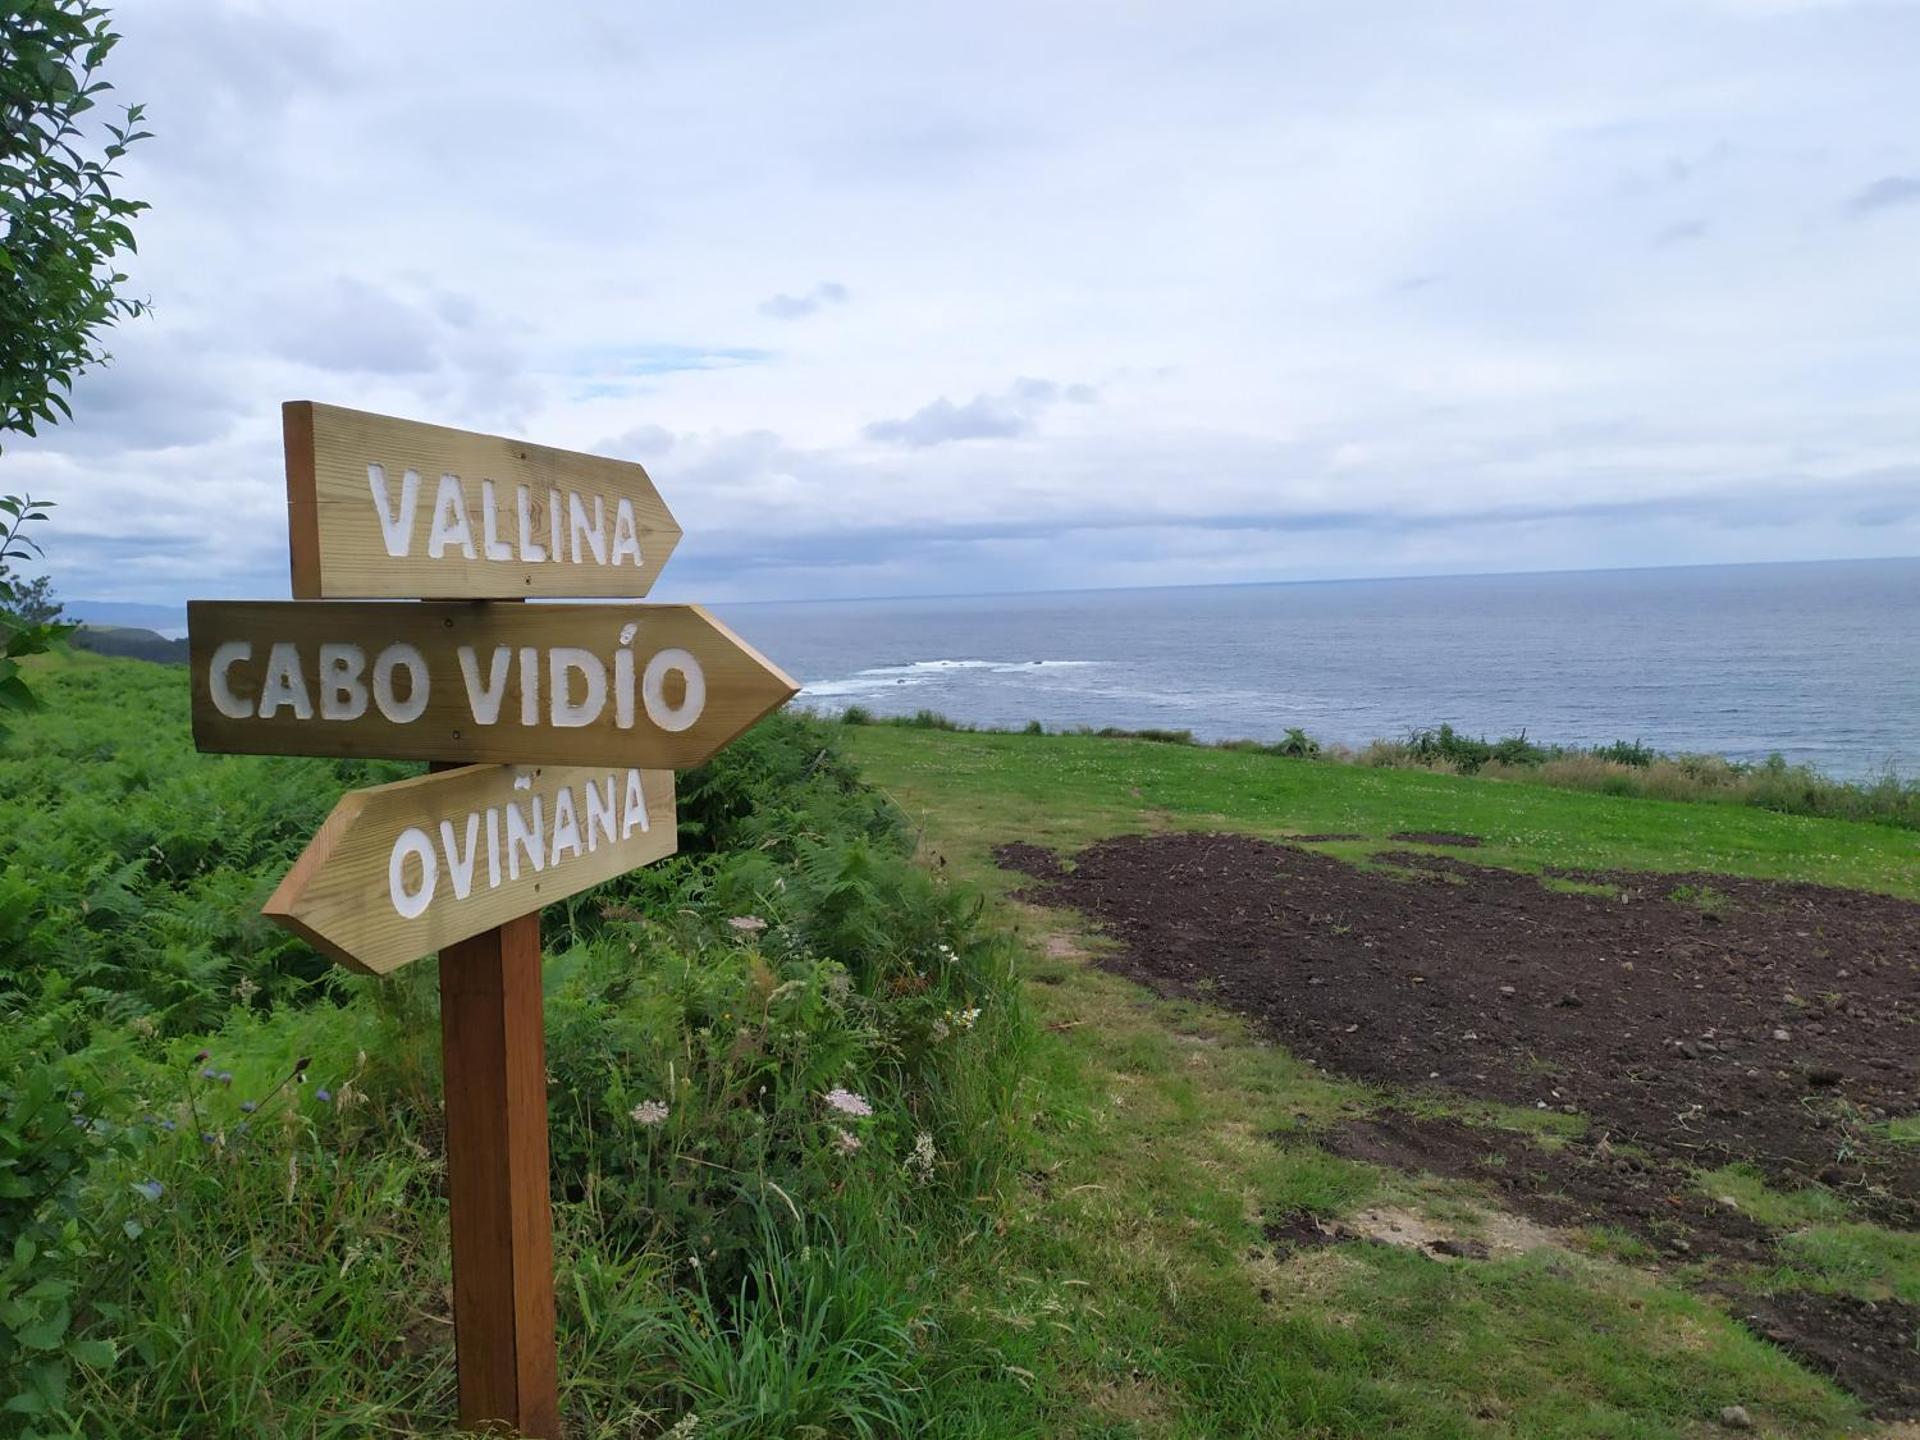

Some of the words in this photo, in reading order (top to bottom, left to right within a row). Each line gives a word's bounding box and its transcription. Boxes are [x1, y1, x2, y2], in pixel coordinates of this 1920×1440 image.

[367, 464, 644, 567] VALLINA
[209, 641, 431, 724] CABO
[458, 623, 706, 732] VIDÍO
[389, 768, 649, 919] OVIÑANA
